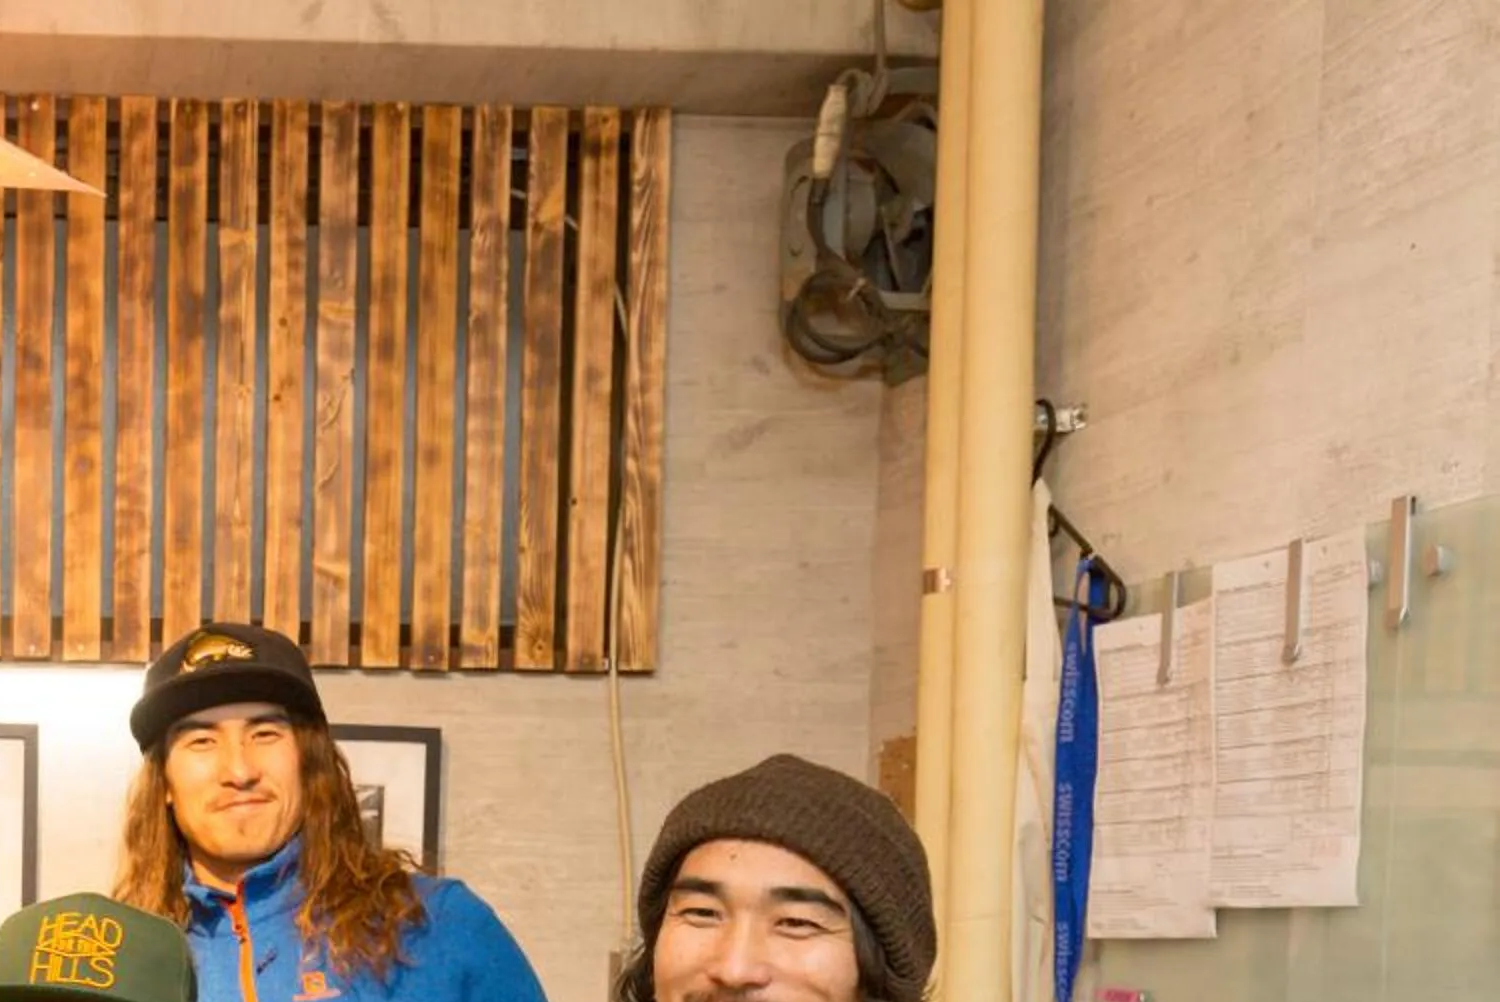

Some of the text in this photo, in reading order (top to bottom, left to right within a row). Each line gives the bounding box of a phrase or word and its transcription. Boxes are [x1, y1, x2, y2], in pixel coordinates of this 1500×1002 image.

[1059, 641, 1080, 743] swisscom
[1056, 782, 1074, 882] swisscom
[38, 911, 123, 950] HEAD
